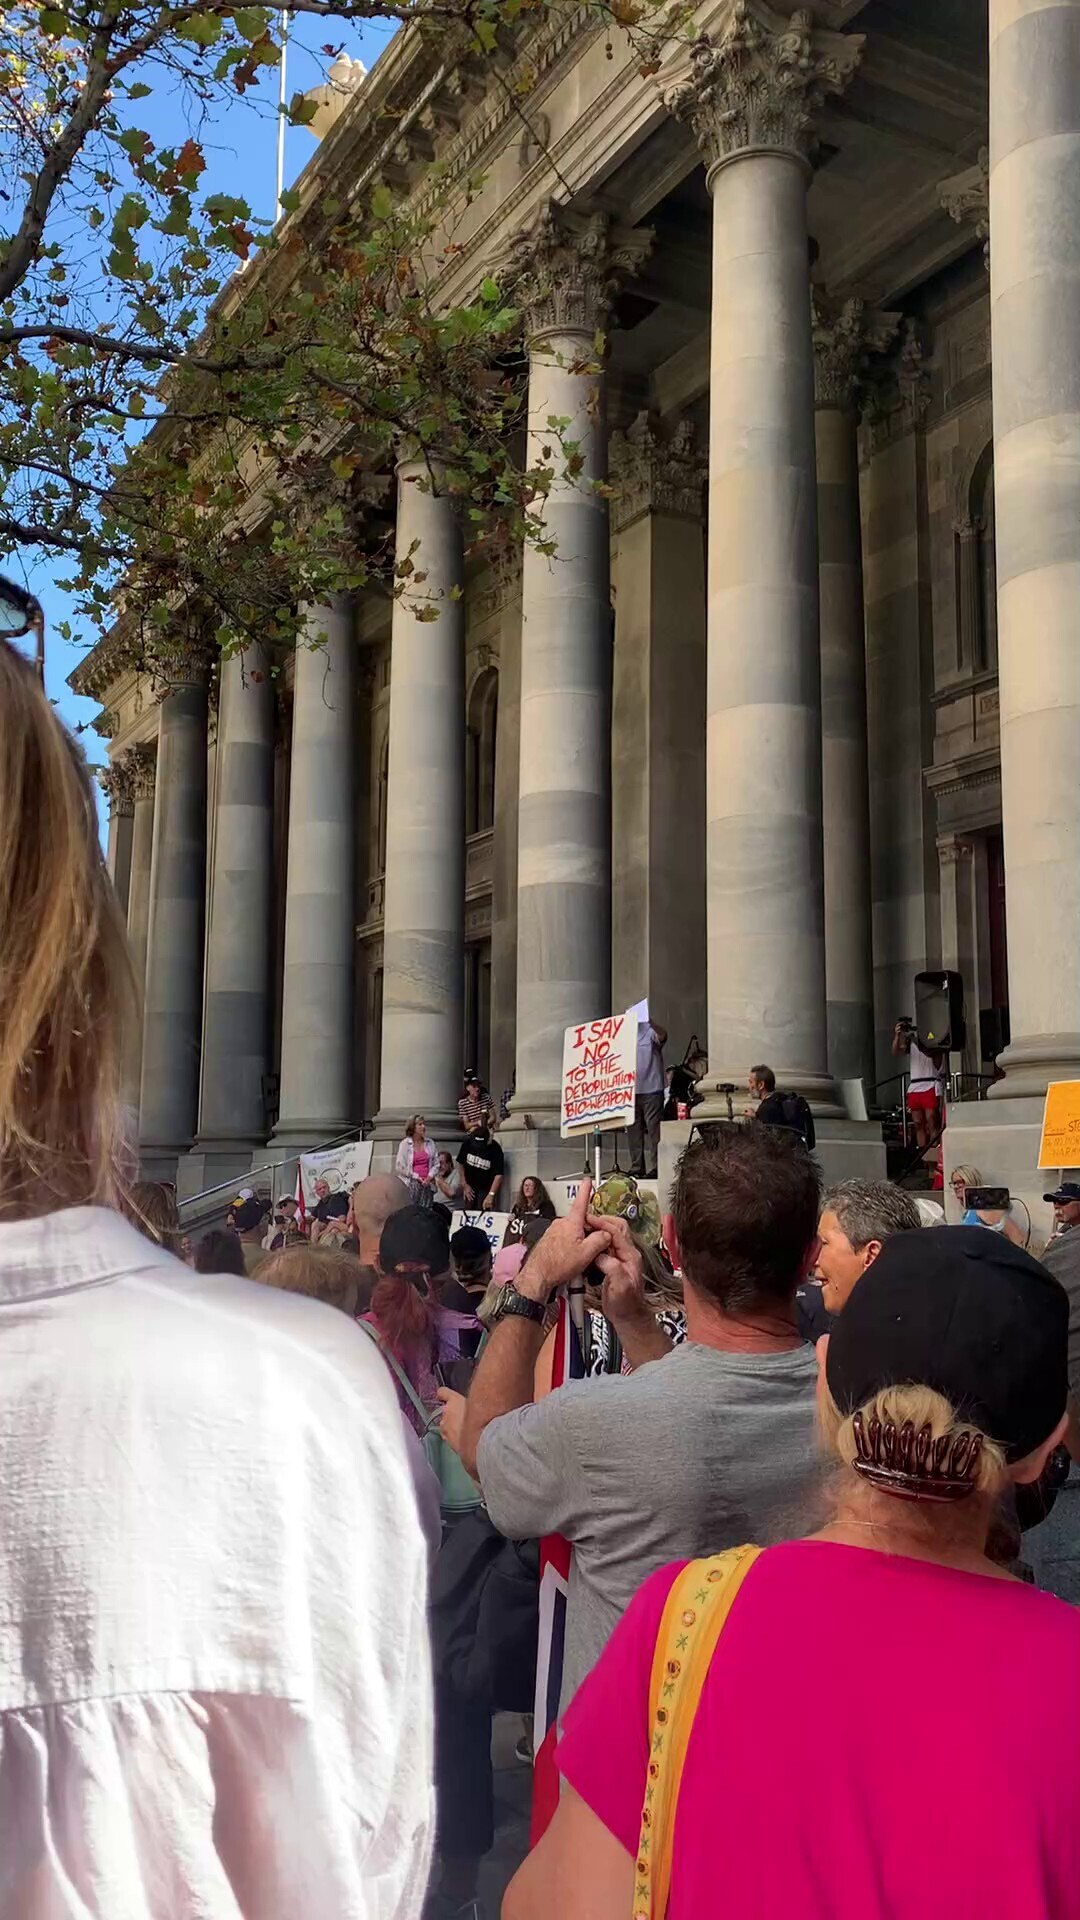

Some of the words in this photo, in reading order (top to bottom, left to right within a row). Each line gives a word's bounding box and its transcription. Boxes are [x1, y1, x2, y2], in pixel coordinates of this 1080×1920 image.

[573, 1026, 586, 1048] I
[588, 1017, 624, 1043] SAY
[583, 1041, 610, 1064] NO
[566, 1066, 587, 1083] TO
[589, 1054, 621, 1077] THE
[564, 1071, 636, 1102] DEPOPULATION
[510, 1218, 528, 1235] St
